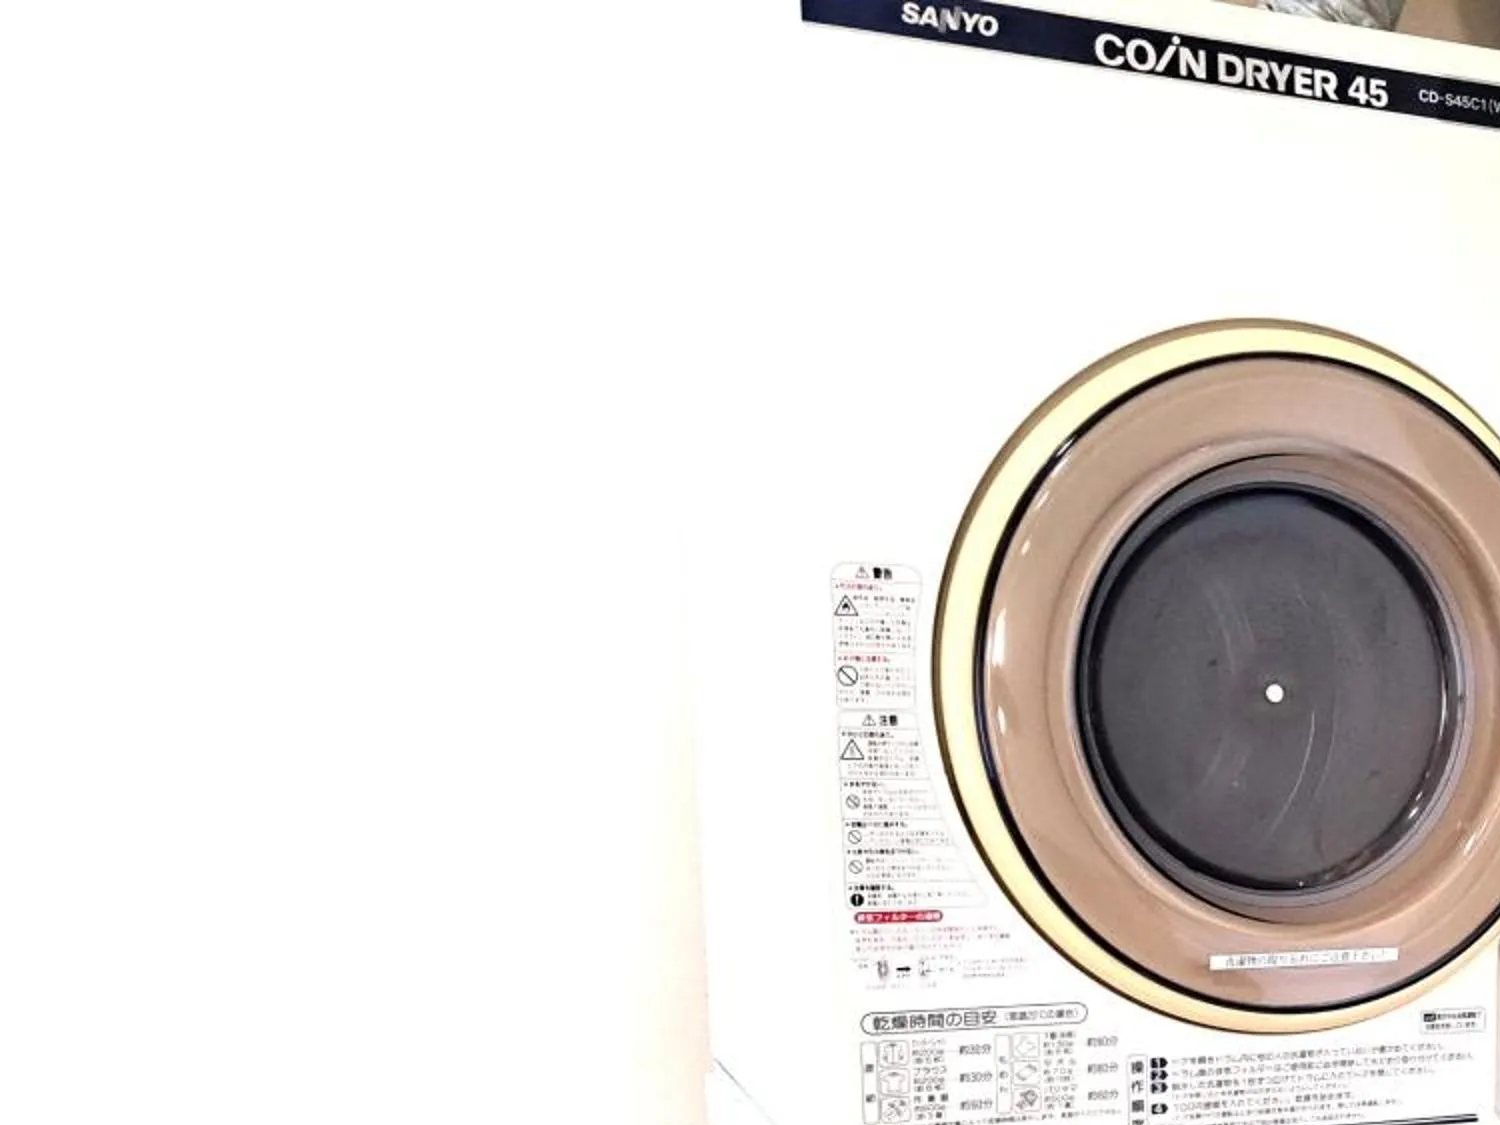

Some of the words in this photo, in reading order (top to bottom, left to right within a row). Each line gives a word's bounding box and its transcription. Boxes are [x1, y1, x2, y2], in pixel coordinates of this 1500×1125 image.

[901, 3, 999, 37] SANYO
[1217, 53, 1338, 100] DRYER
[1347, 76, 1388, 108] 45
[872, 1010, 997, 1031] 乾燥時間の目安
